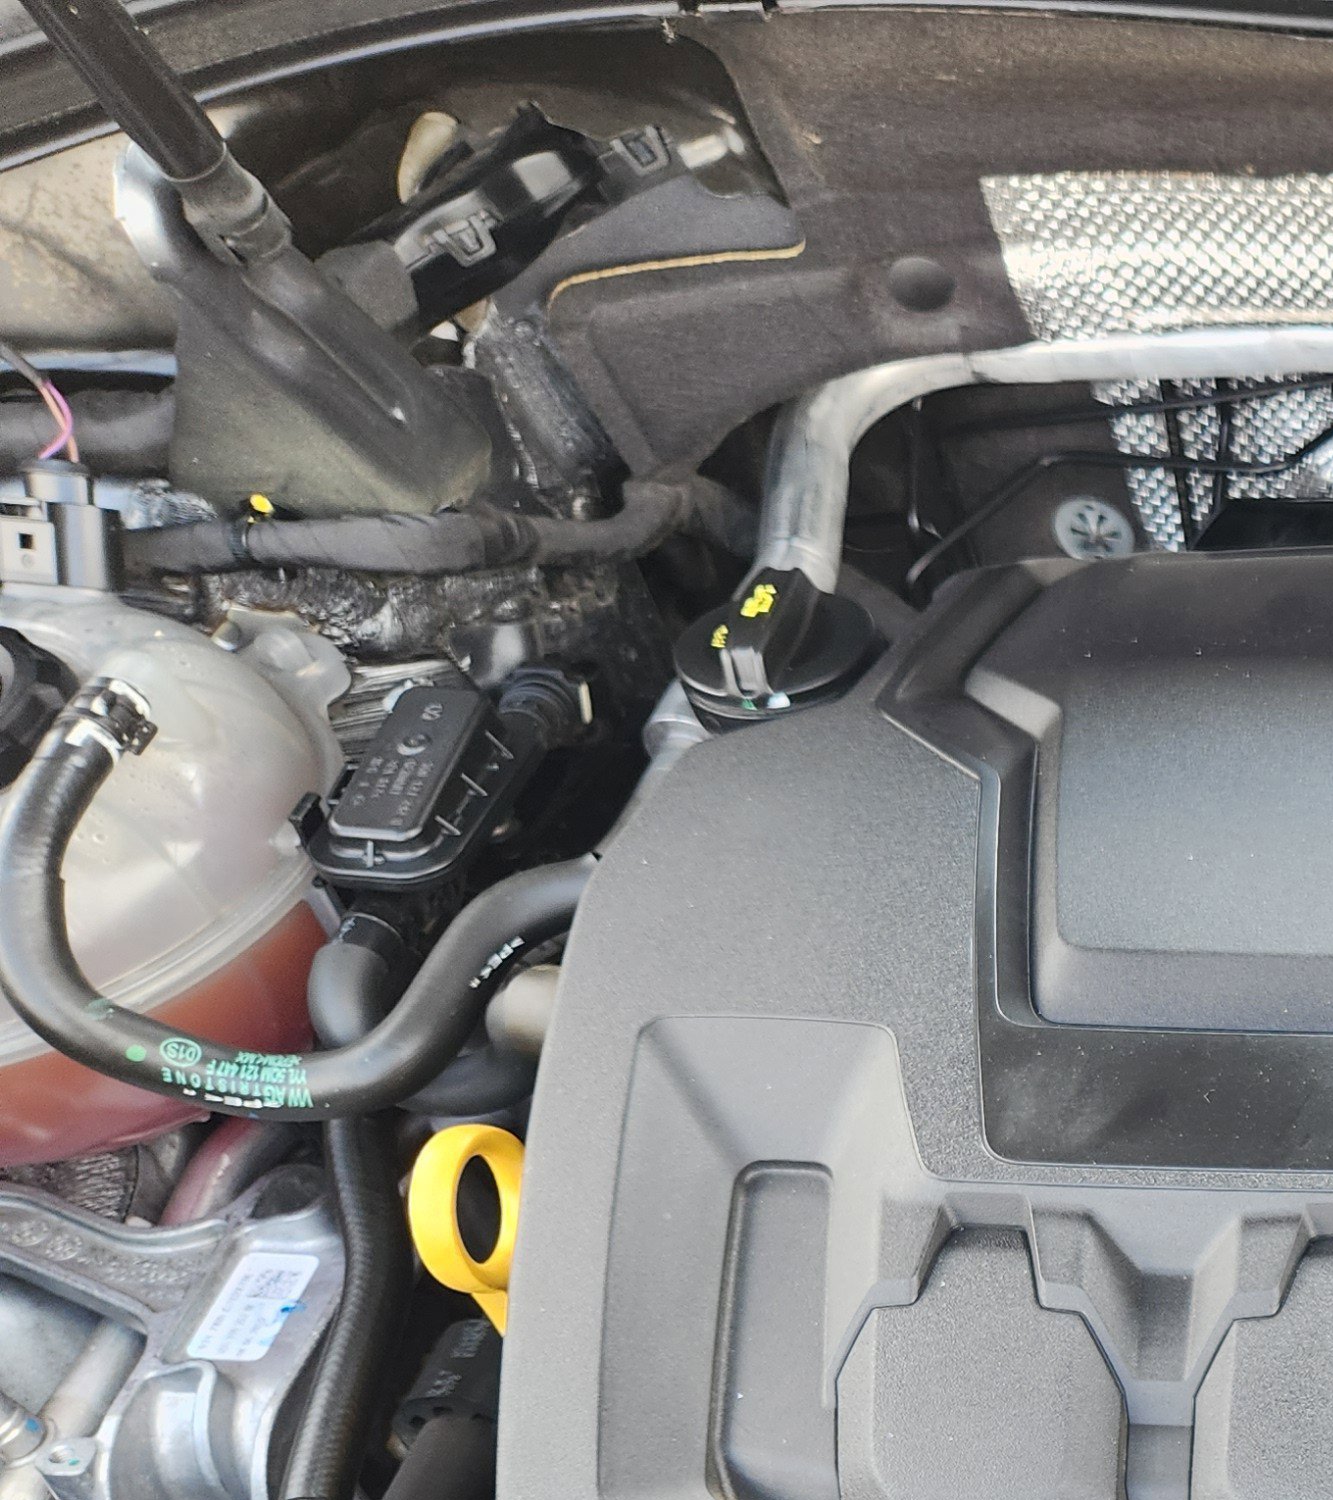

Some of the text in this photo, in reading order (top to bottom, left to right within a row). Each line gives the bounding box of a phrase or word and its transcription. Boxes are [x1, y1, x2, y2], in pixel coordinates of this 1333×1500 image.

[205, 1059, 217, 1075] F
[240, 1064, 259, 1080] 121
[161, 1066, 262, 1097] TRISTONE
[288, 1087, 314, 1108] VW
